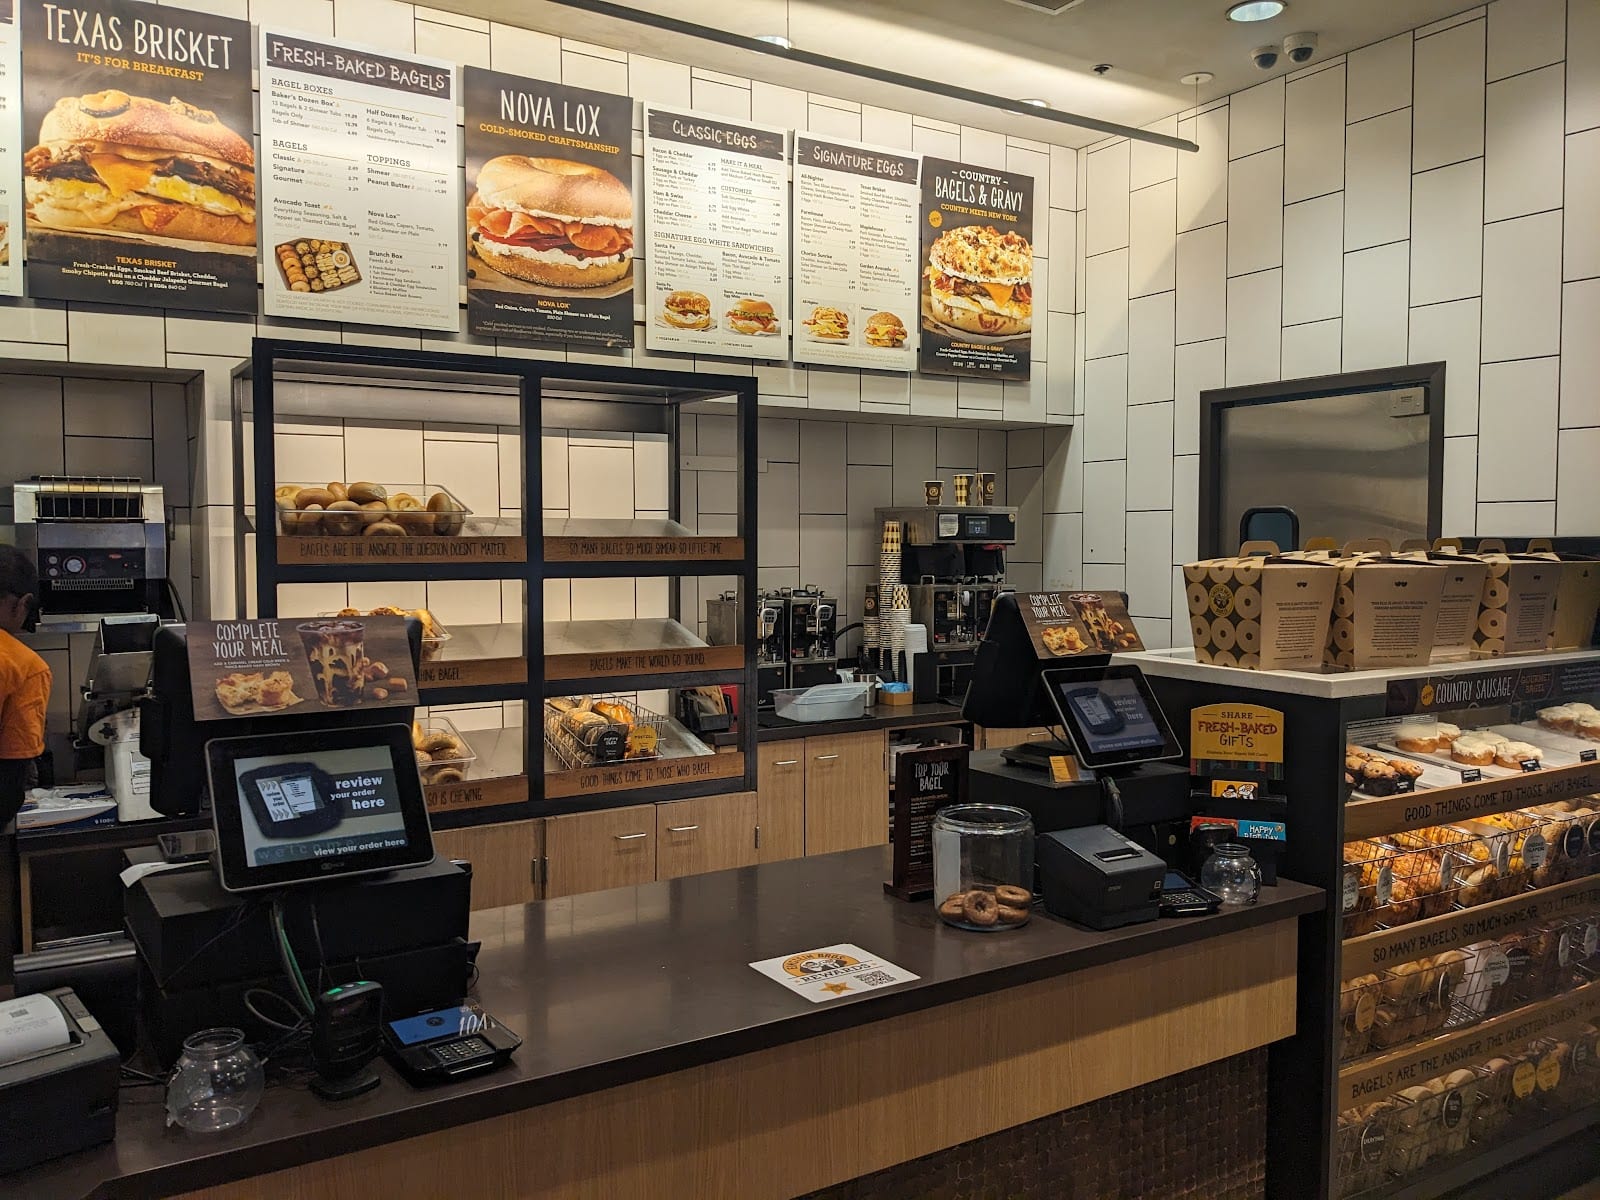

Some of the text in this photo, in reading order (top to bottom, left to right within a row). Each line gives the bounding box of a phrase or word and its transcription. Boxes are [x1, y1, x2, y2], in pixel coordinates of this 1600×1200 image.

[43, 4, 232, 70] TEXAS BRISKET
[77, 52, 204, 81] IT'S FOR BREAKFAST
[272, 41, 445, 91] FRESH-BAKED BAGELS
[271, 78, 334, 95] BAGEL BOXES
[271, 91, 319, 105] Baker's Dozen
[271, 109, 290, 119] Bagels
[366, 108, 400, 120] Half Dozen
[501, 89, 600, 137] NOVA LOX
[366, 126, 384, 135] Bagels
[672, 119, 757, 149] CLASSIC EGGS
[272, 139, 308, 151] BAGELS
[479, 123, 620, 155] COLD-SMOKED CRAFTSMANSHIP
[272, 153, 296, 162] Classic
[366, 154, 411, 167] TOPPINGS
[813, 145, 904, 177] SIGNATURE EGGS
[272, 163, 305, 175] Signature
[367, 167, 390, 177] Shmear
[272, 174, 303, 184] Gourmet
[367, 178, 411, 190] Peanut Butter
[960, 170, 1001, 186] COUNTRY
[721, 186, 752, 195] CUSTOMIZE
[935, 176, 1023, 212] BAGELS & GRAVY
[273, 197, 321, 209] Avocado Toast
[653, 208, 692, 219] Cheddar Cheese
[941, 203, 1017, 222] COUNTRY MEETS NEW YORK
[653, 231, 774, 253] SIGNATURE EGG WHITE SANDWICHES
[369, 250, 403, 260] Brunch Box
[116, 256, 177, 269] TEXAS BRISKET
[73, 261, 117, 272] Fresh-Cracked
[134, 266, 156, 275] Smoked
[193, 271, 218, 281] Cheddar,
[300, 542, 329, 556] BAGELS
[333, 542, 347, 556] ARE
[351, 542, 364, 556] THE
[401, 542, 414, 556] THE
[416, 542, 448, 556] QUESTION
[450, 542, 476, 556] DOESN'T
[569, 543, 578, 555] SO
[581, 543, 598, 554] MANY
[601, 543, 623, 554] BAGELS
[626, 543, 634, 554] SO
[637, 543, 652, 554] MUCH
[679, 543, 687, 554] SO
[689, 543, 706, 554] LITTLE
[1029, 594, 1063, 606] COMPLETE
[1031, 605, 1071, 618] YOUR MEAL
[216, 622, 281, 641] COMPLETE
[212, 639, 288, 659] YOUR MEAL
[590, 655, 613, 671] BAGELS
[616, 655, 632, 670] MAKE
[635, 654, 646, 669] THE
[648, 654, 669, 668] WORLD
[672, 653, 681, 666] GO
[1521, 673, 1551, 684] GOURMET
[1435, 680, 1473, 704] COUNTRY
[1475, 676, 1513, 699] SAUSAGE
[1525, 684, 1545, 694] BAGEL
[1114, 698, 1137, 706] review
[1221, 712, 1253, 720] SHARE
[1197, 721, 1278, 735] FRESH-BAKED
[1219, 734, 1254, 748] GIFTS
[580, 774, 599, 788] GOOD
[602, 773, 623, 787] THINGS
[625, 770, 643, 784] COME
[645, 769, 654, 782] TO
[656, 767, 674, 781] THOSE
[676, 765, 690, 778] WHO
[915, 762, 949, 778] TOP YOUR
[335, 776, 383, 789] review
[920, 776, 943, 791] BAGEL
[330, 788, 376, 801] your order
[427, 787, 483, 805] SO IS CHEWING
[1404, 806, 1431, 823] GOOD
[1436, 797, 1471, 816] THINGS
[1474, 792, 1498, 809] COME
[1501, 790, 1513, 803] TO
[1515, 785, 1543, 801] THOSE
[1545, 780, 1565, 796] WHO
[352, 797, 385, 810] here
[1249, 825, 1274, 835] HAPPY
[314, 838, 405, 857] view your order here
[1373, 948, 1386, 963] SO
[1388, 939, 1418, 959] MANY
[1462, 923, 1475, 936] SO
[1476, 916, 1501, 935] MUCH
[802, 963, 871, 983] REWARDS
[1352, 1076, 1394, 1098] BAGELS
[1396, 1064, 1416, 1081] ARE
[1419, 1056, 1439, 1072] THE
[1486, 1034, 1504, 1048] THE
[1505, 1017, 1547, 1043] QUESTION
